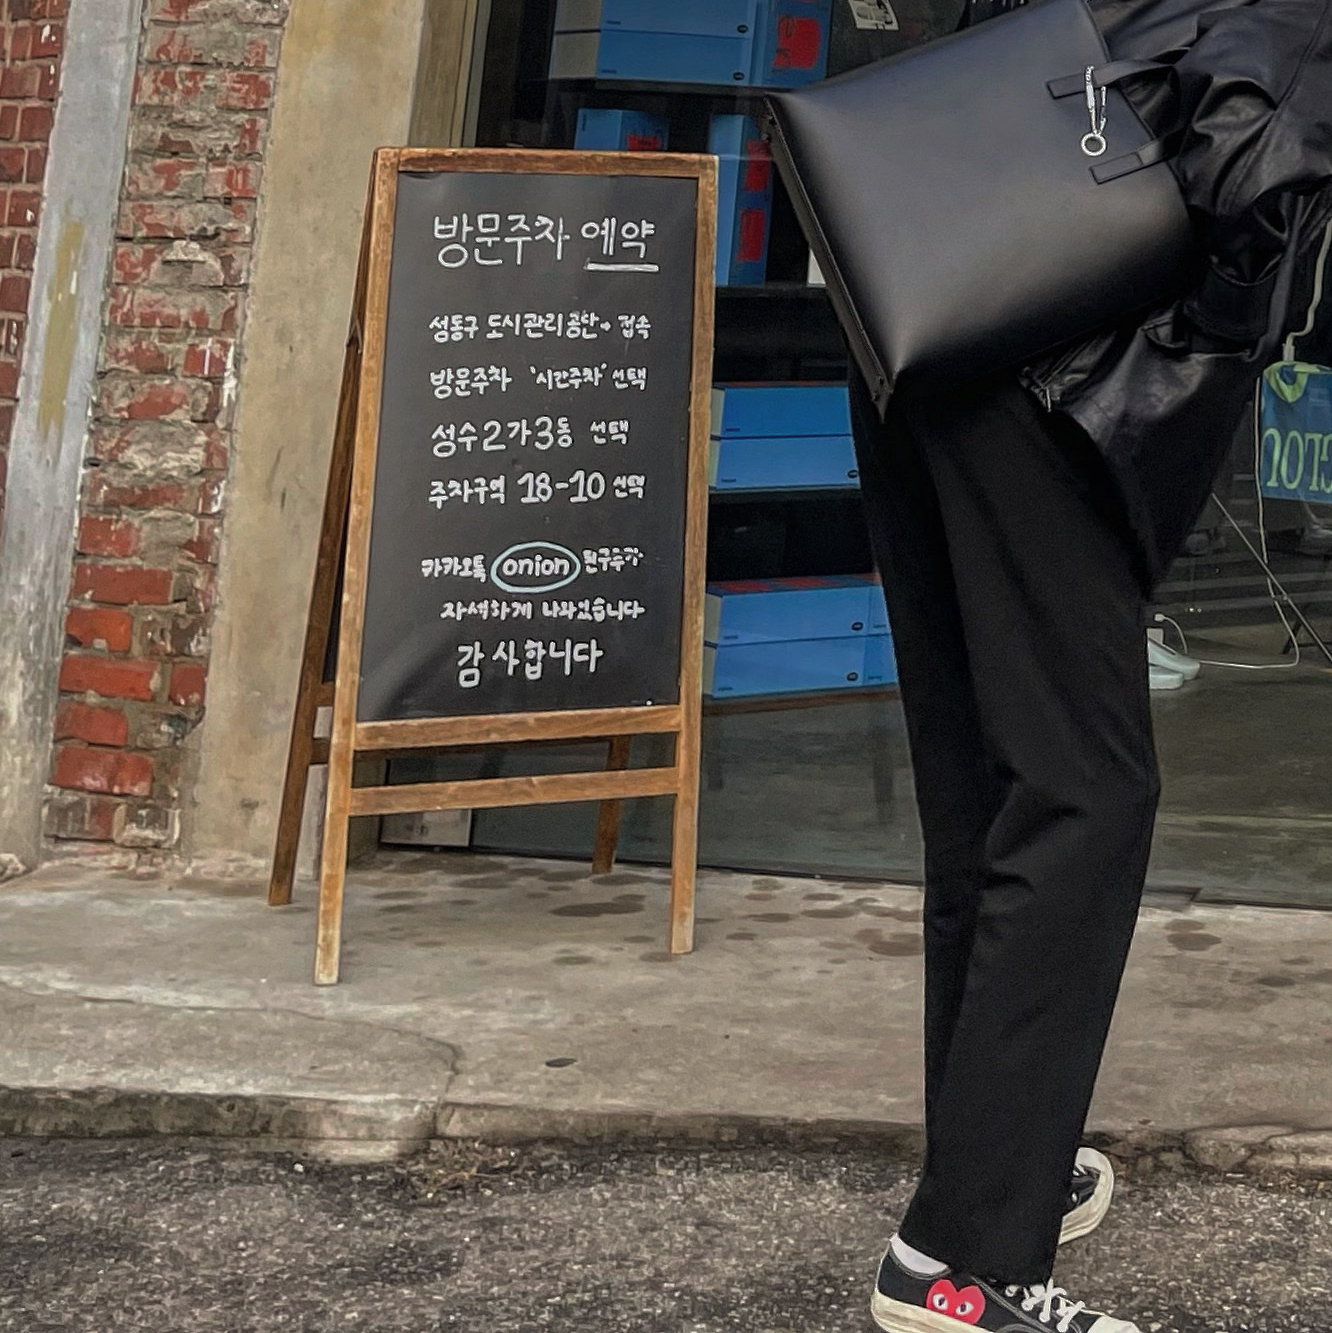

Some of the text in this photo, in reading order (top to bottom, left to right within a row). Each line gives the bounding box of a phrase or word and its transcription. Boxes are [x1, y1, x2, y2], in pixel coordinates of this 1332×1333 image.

[433, 213, 656, 268] 방문주차 예약
[429, 313, 480, 343] 성동구
[617, 314, 651, 340] 접속
[430, 365, 513, 399] 방문주차
[612, 367, 648, 391] 선택
[431, 416, 630, 457] 성수2가3동 선택
[428, 469, 646, 509] 주차구역 18-10 선택
[421, 553, 487, 583] 카카오톡
[502, 554, 570, 577] onion
[440, 597, 646, 623] 자세하게 나와있습니다
[457, 638, 604, 689] 감사합니다
